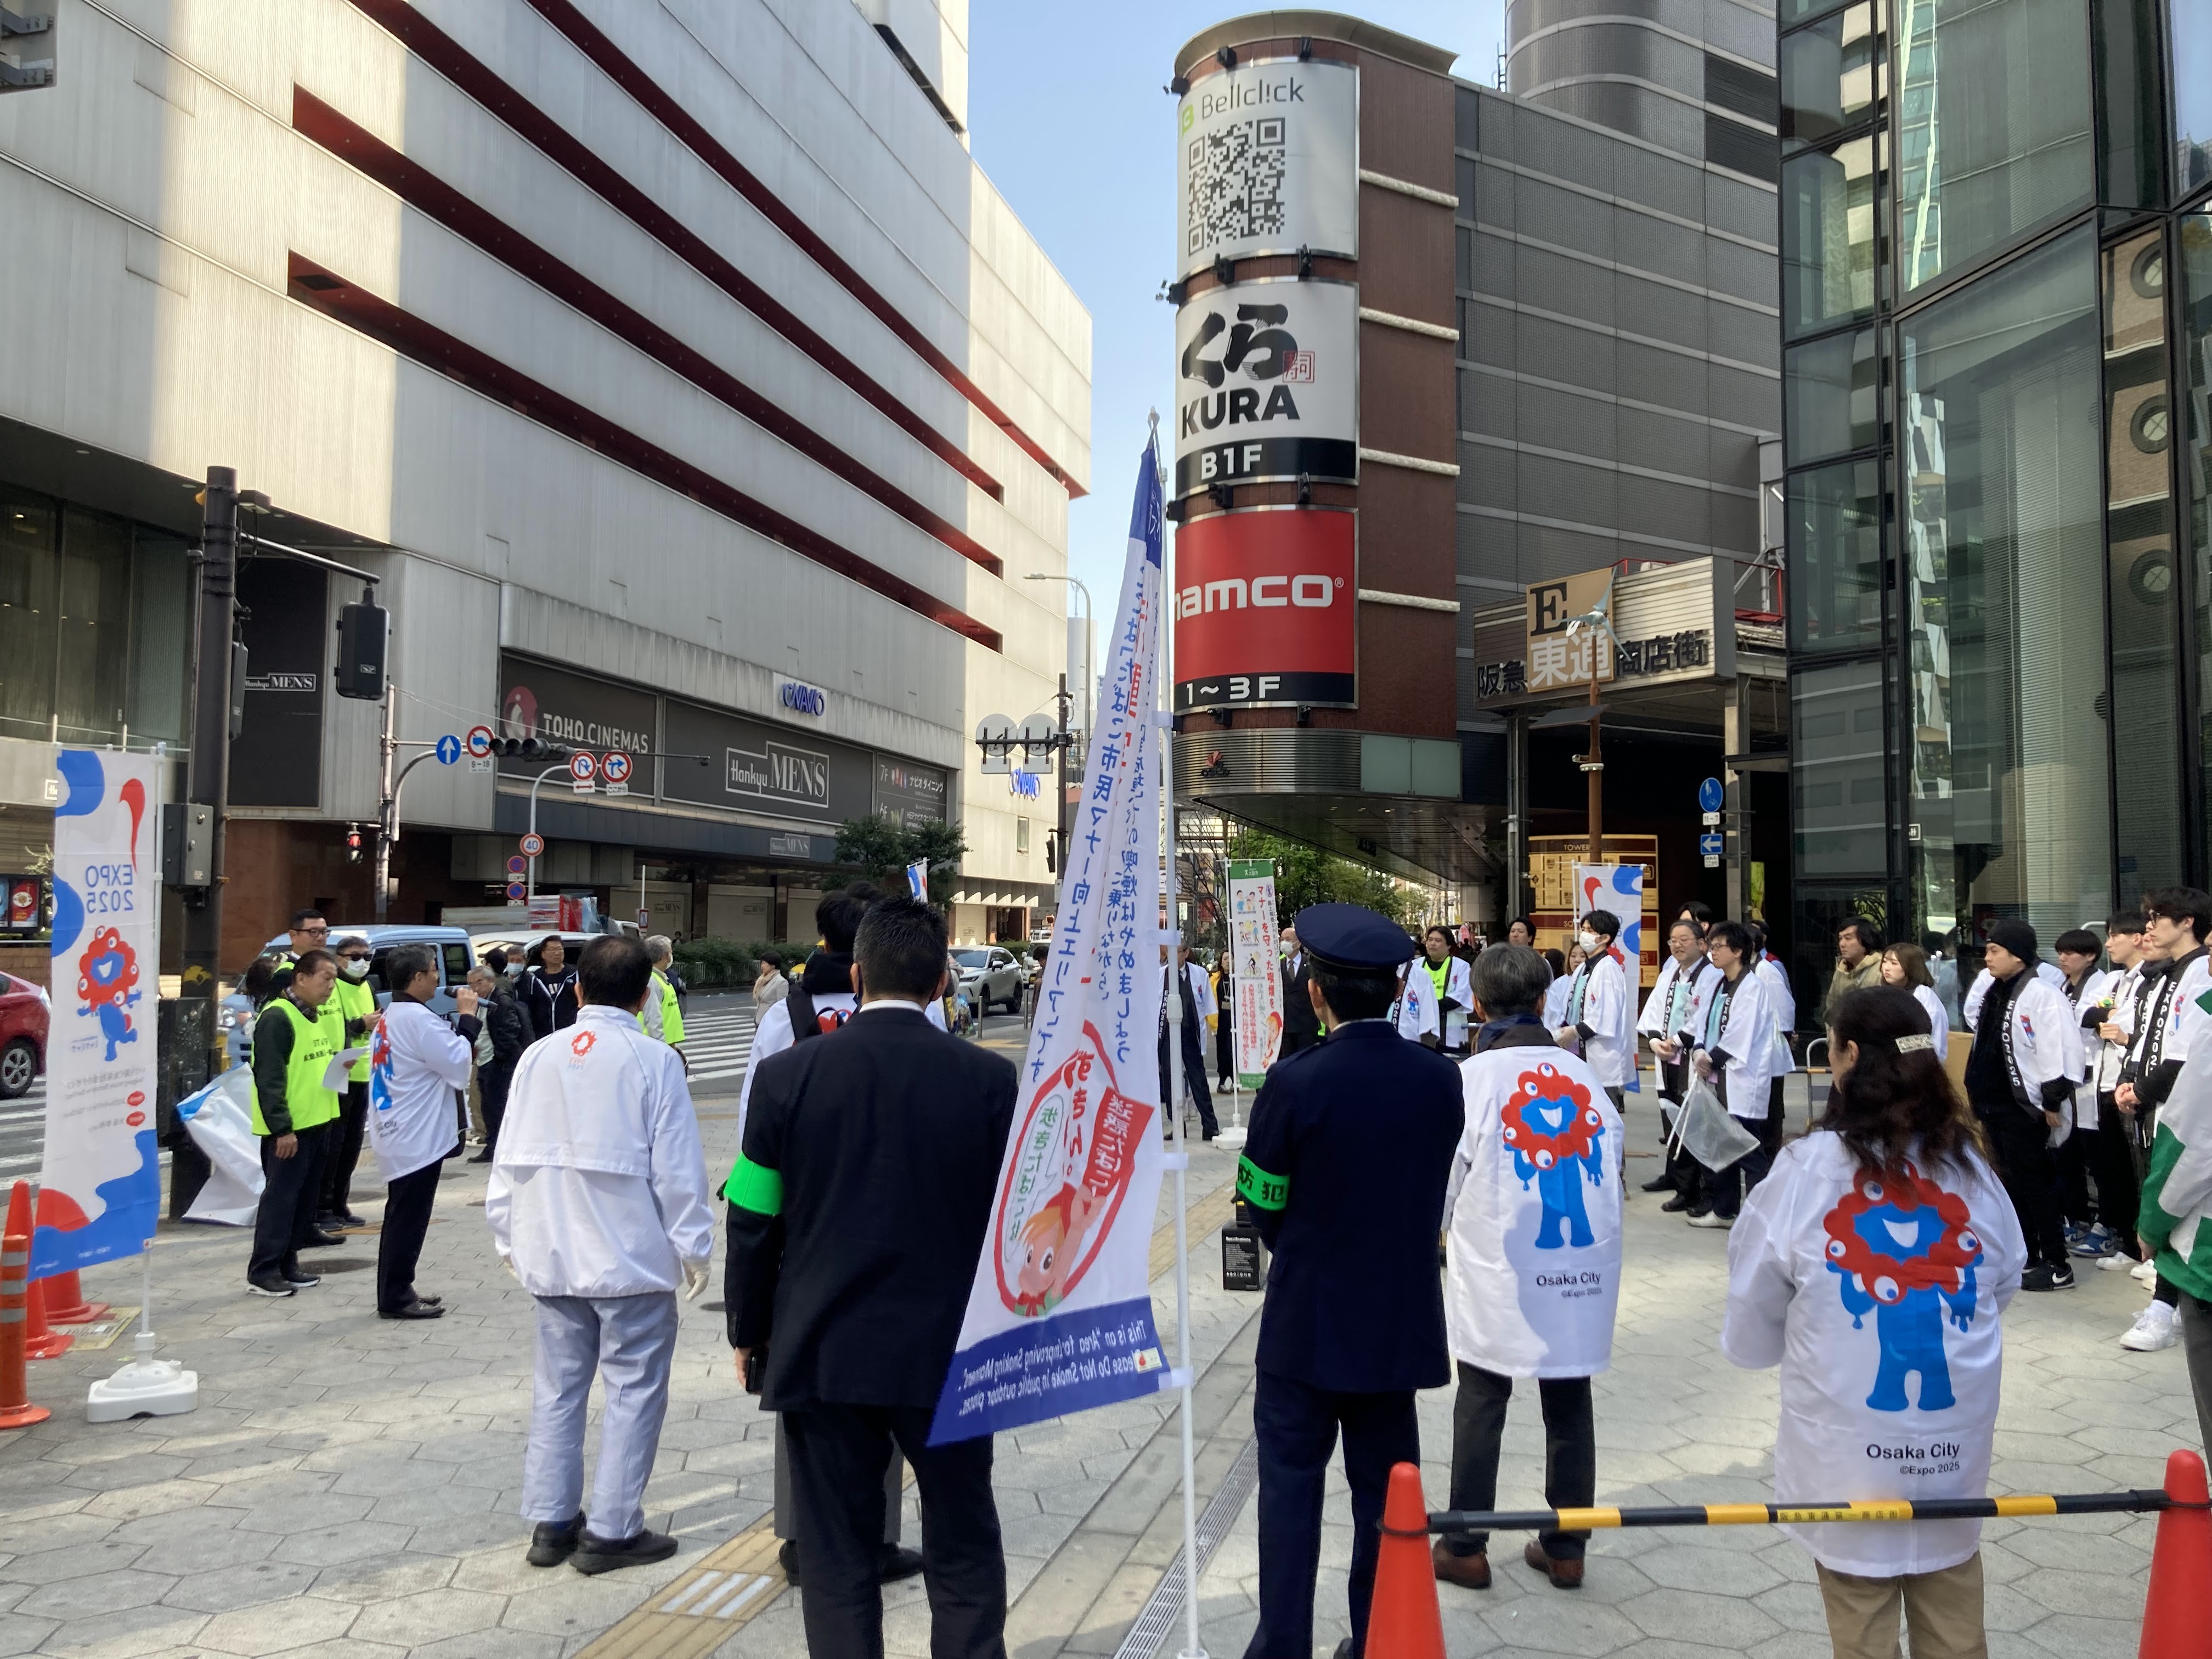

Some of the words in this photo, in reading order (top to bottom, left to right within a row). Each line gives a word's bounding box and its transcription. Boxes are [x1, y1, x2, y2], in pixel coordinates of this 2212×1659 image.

[1181, 303, 1298, 389] くら
[1182, 385, 1301, 441] KURA
[1201, 444, 1262, 480] B1F
[543, 712, 585, 740] TOHO
[587, 723, 649, 754] CINEMAS
[730, 759, 768, 794] Hankyu
[525, 840, 538, 850] 40
[2149, 981, 2177, 1070] EXPO202
[1536, 1273, 1578, 1287] Osaka
[1580, 1272, 1601, 1286] City
[1866, 1443, 1925, 1460] Osaka
[1930, 1442, 1960, 1460] City
[1937, 1461, 1960, 1474] 2025
